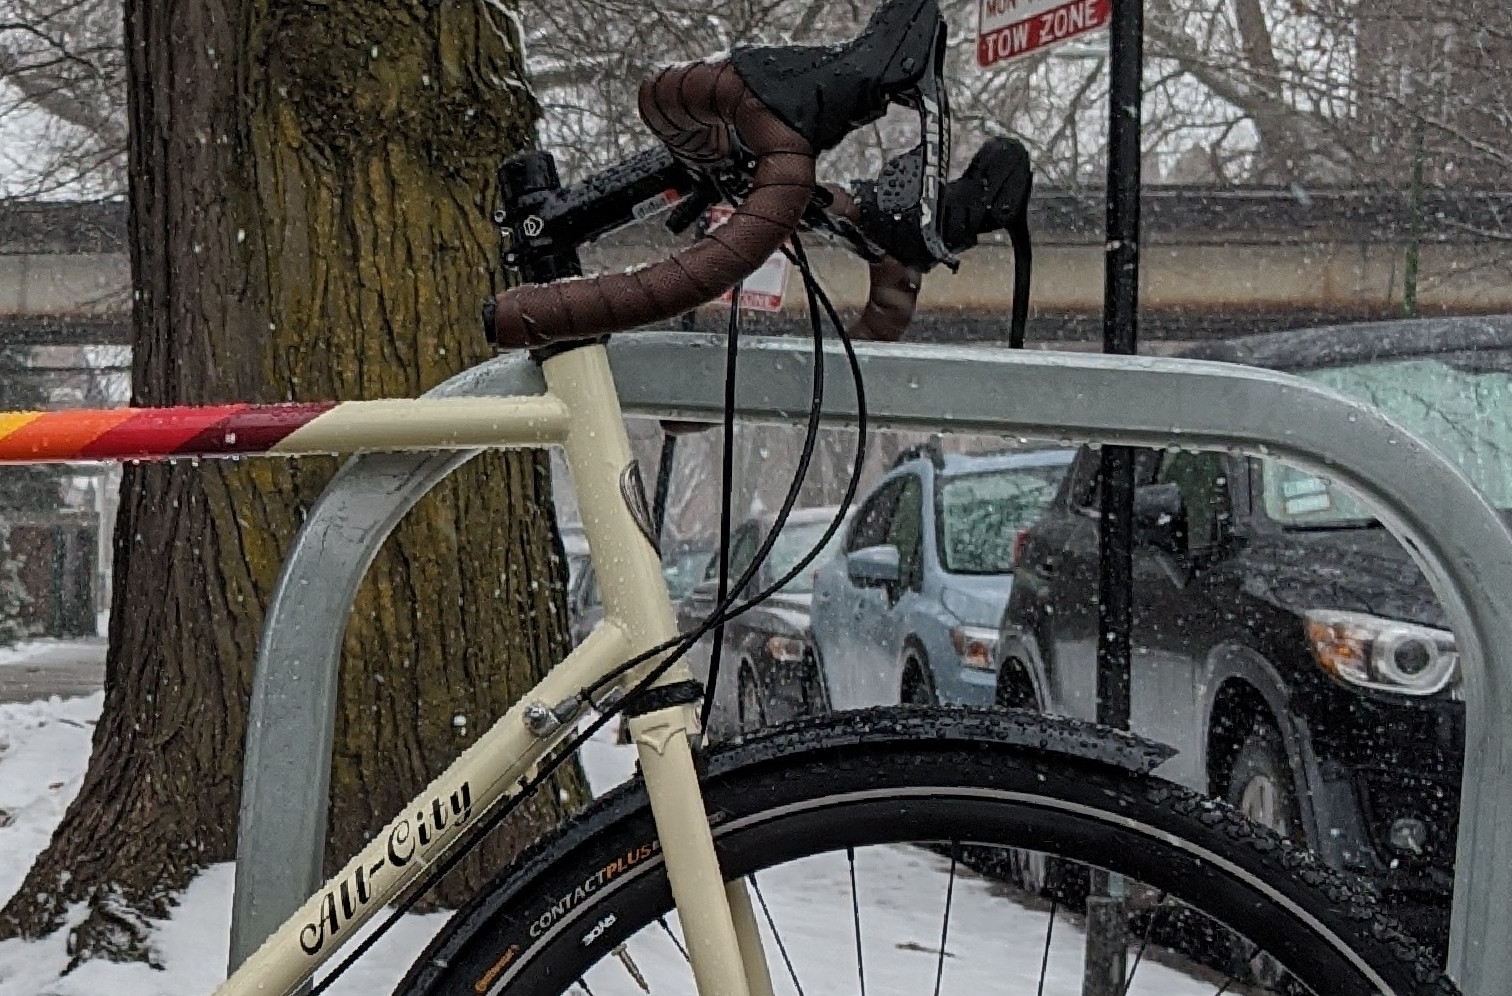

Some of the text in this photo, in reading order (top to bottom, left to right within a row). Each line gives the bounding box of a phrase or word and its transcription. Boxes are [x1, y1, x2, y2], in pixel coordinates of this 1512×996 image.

[985, 0, 1098, 62] TOW ZONE
[300, 782, 472, 956] All-City
